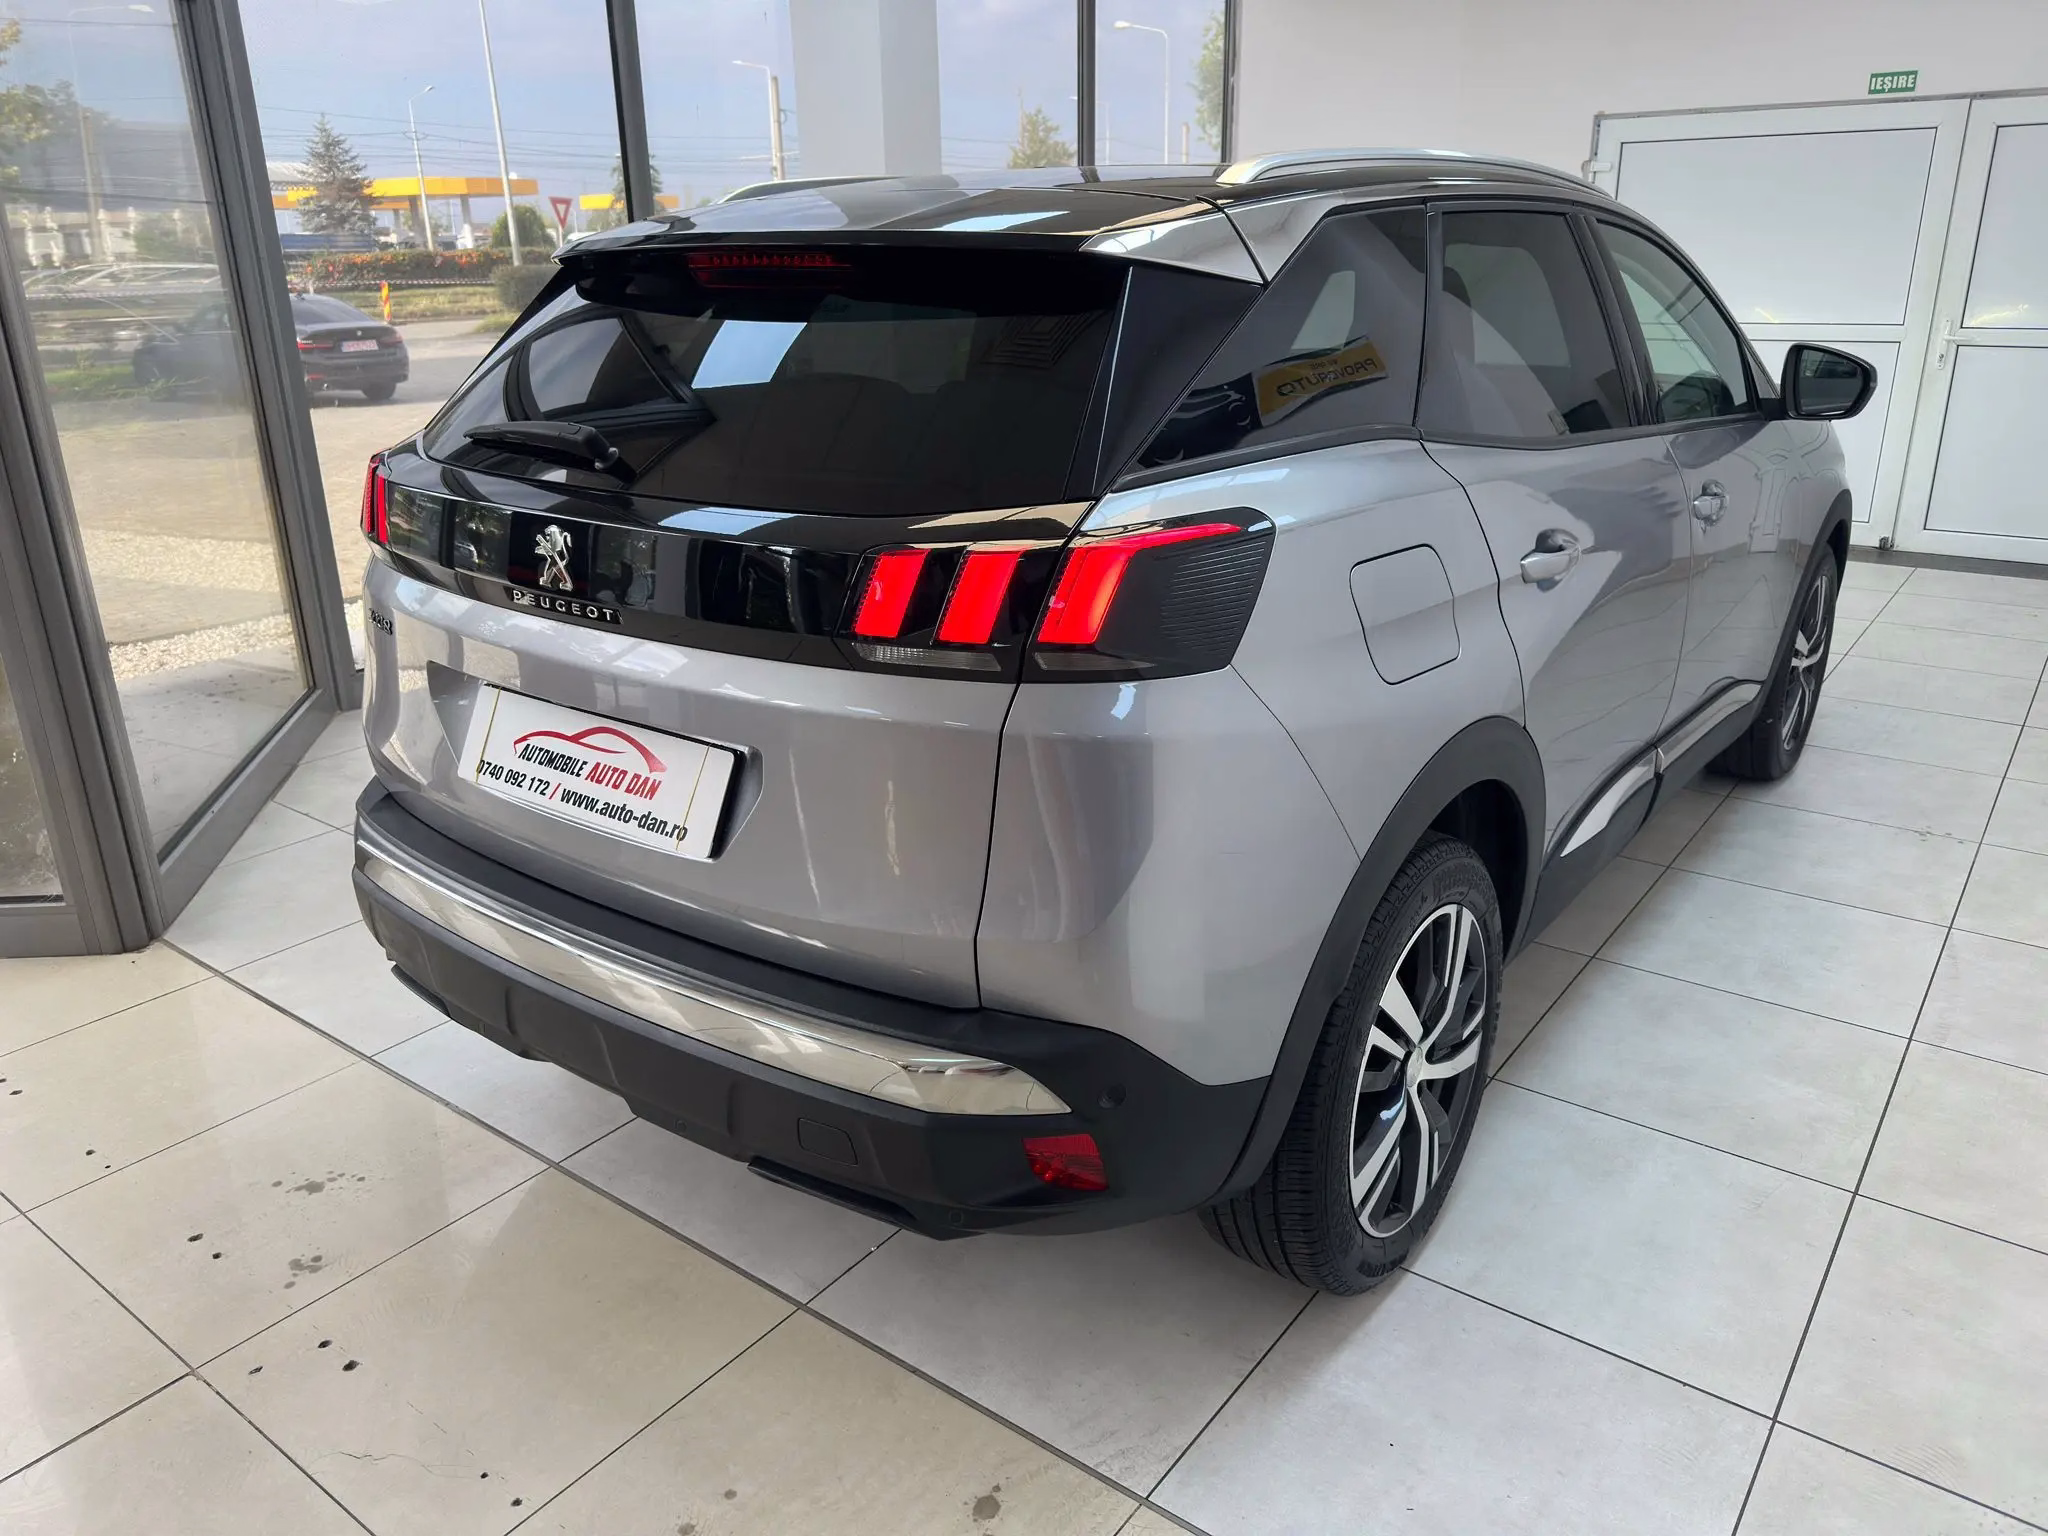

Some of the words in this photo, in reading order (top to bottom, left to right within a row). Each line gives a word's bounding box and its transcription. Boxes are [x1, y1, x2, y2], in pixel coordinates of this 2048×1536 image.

[513, 590, 613, 621] PEUGEOT
[476, 759, 501, 780] 0740
[504, 772, 524, 789] 092
[529, 777, 550, 796] 172
[561, 787, 688, 842] www.auto-dan.ro
[518, 743, 588, 778] AUTOMOBILE
[585, 762, 628, 789] AUTO
[624, 773, 662, 801] DAN
